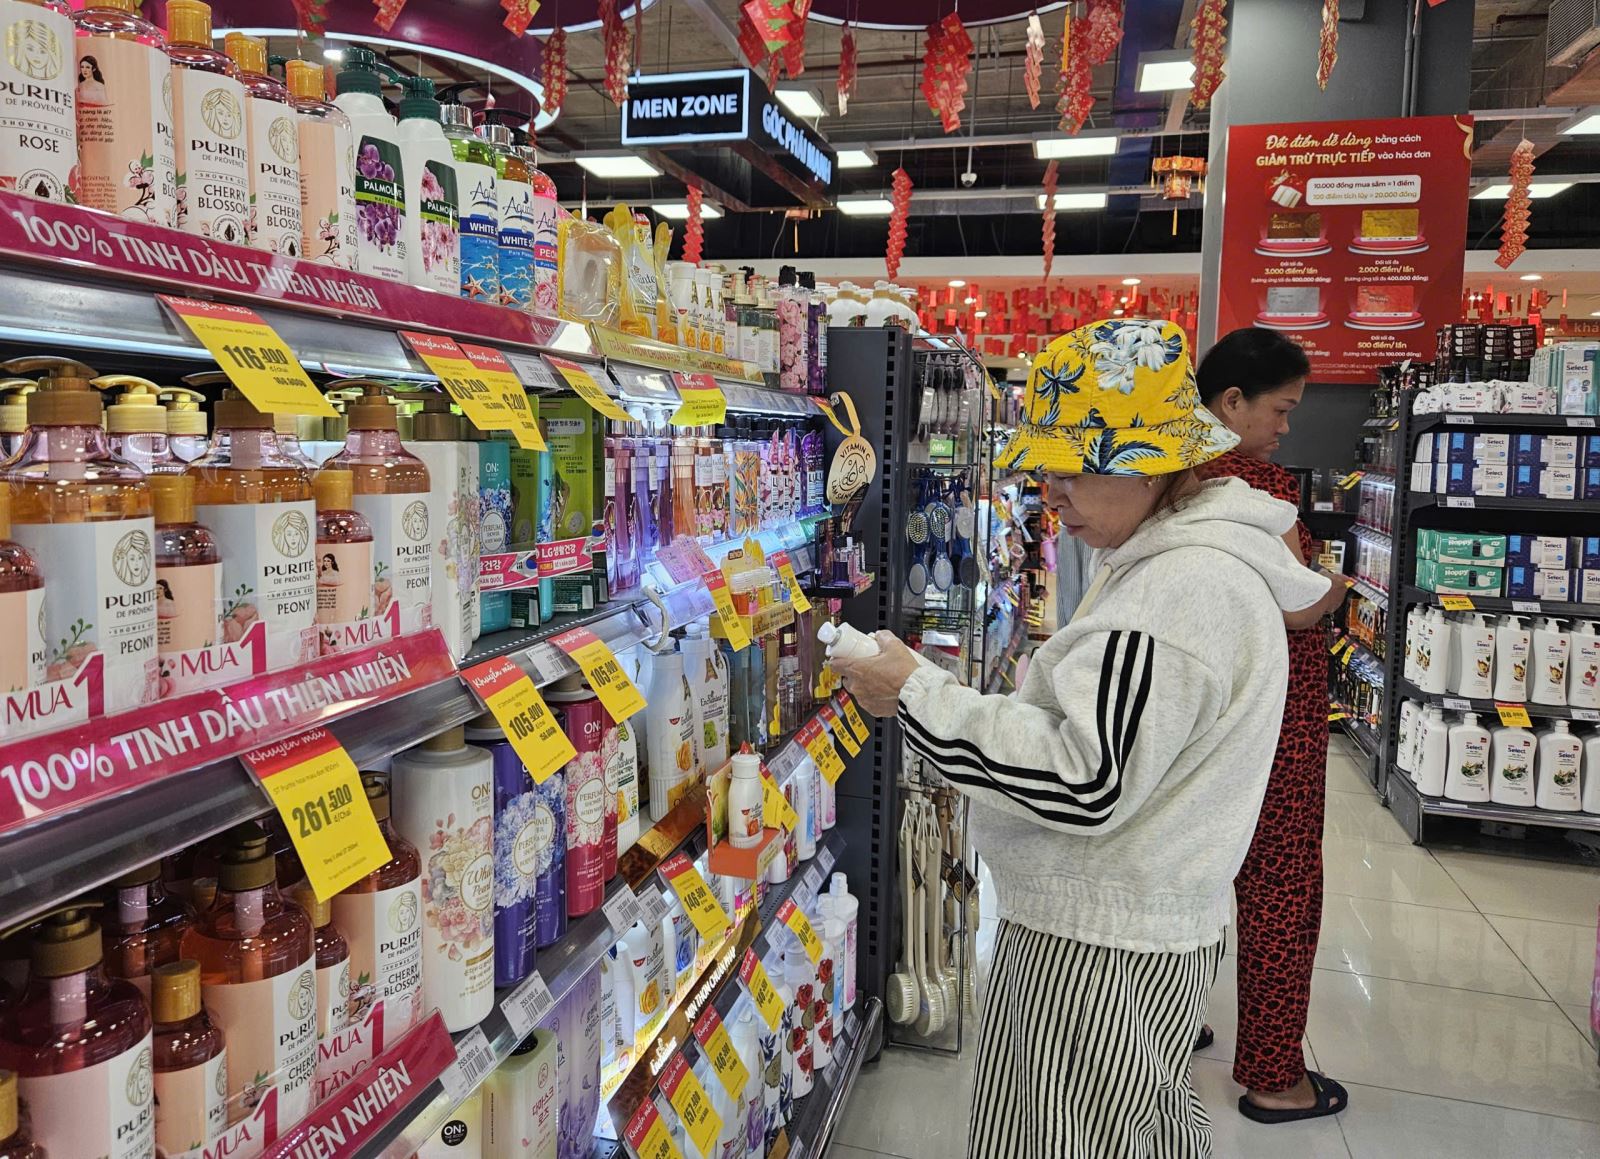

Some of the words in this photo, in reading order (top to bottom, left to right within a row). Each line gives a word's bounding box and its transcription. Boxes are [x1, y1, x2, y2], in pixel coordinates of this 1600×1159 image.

[5, 97, 17, 106] DE
[632, 97, 677, 119] MEN
[680, 93, 738, 117] ZONE
[762, 103, 786, 146] GÓC
[19, 134, 60, 154] ROSE
[1290, 133, 1320, 149] điểm
[1322, 132, 1338, 147] dễ
[1340, 131, 1373, 149] dàng
[1375, 134, 1398, 145] bằng
[1399, 134, 1422, 143] cách
[1255, 152, 1288, 167] GIẢM
[1315, 152, 1347, 167] TRỰC
[1349, 148, 1376, 164] TIẾP
[1378, 151, 1394, 160] vào
[1395, 149, 1412, 159] hóa
[1414, 149, 1431, 159] đơn
[203, 184, 246, 202] CHERRY
[198, 197, 249, 217] BLOSSOM
[271, 204, 300, 220] CHERR
[266, 215, 301, 233] BLOSSO
[469, 222, 496, 235] WHITE
[502, 235, 528, 247] WHITE
[14, 210, 113, 259] 100%
[109, 235, 190, 276] TINH
[191, 239, 250, 286] DẦU
[247, 258, 318, 300] THIÊN
[313, 274, 382, 311] NHIÊN
[1357, 341, 1371, 349] 500
[840, 443, 867, 459] VITAMIN
[865, 453, 871, 461] C
[486, 462, 500, 473] ON:
[273, 576, 282, 585] DE
[406, 576, 430, 589] PEONY
[116, 610, 126, 619] DE
[277, 599, 311, 616] PEONY
[345, 618, 383, 647] MUA
[384, 600, 402, 638] 1
[121, 634, 154, 655] PEONY
[181, 646, 240, 678] MUA
[239, 621, 268, 675] 1
[7, 684, 73, 725] MUA
[73, 653, 105, 719] 1
[1, 744, 115, 800] 100%
[110, 716, 200, 771] TINH
[199, 688, 265, 744] DẦU
[264, 673, 339, 722] THIÊN
[339, 651, 411, 702] NHIÊN
[471, 781, 491, 800] ON:
[292, 783, 353, 839] 261.500
[388, 963, 419, 985] CHERRY
[384, 971, 421, 997] BLOSSOM
[318, 1027, 363, 1063] MUA
[363, 1001, 385, 1060] 1
[341, 1058, 412, 1135] NHIÊN
[202, 1123, 253, 1159] MUA
[253, 1086, 279, 1150] 1
[444, 1123, 465, 1136] ON:
